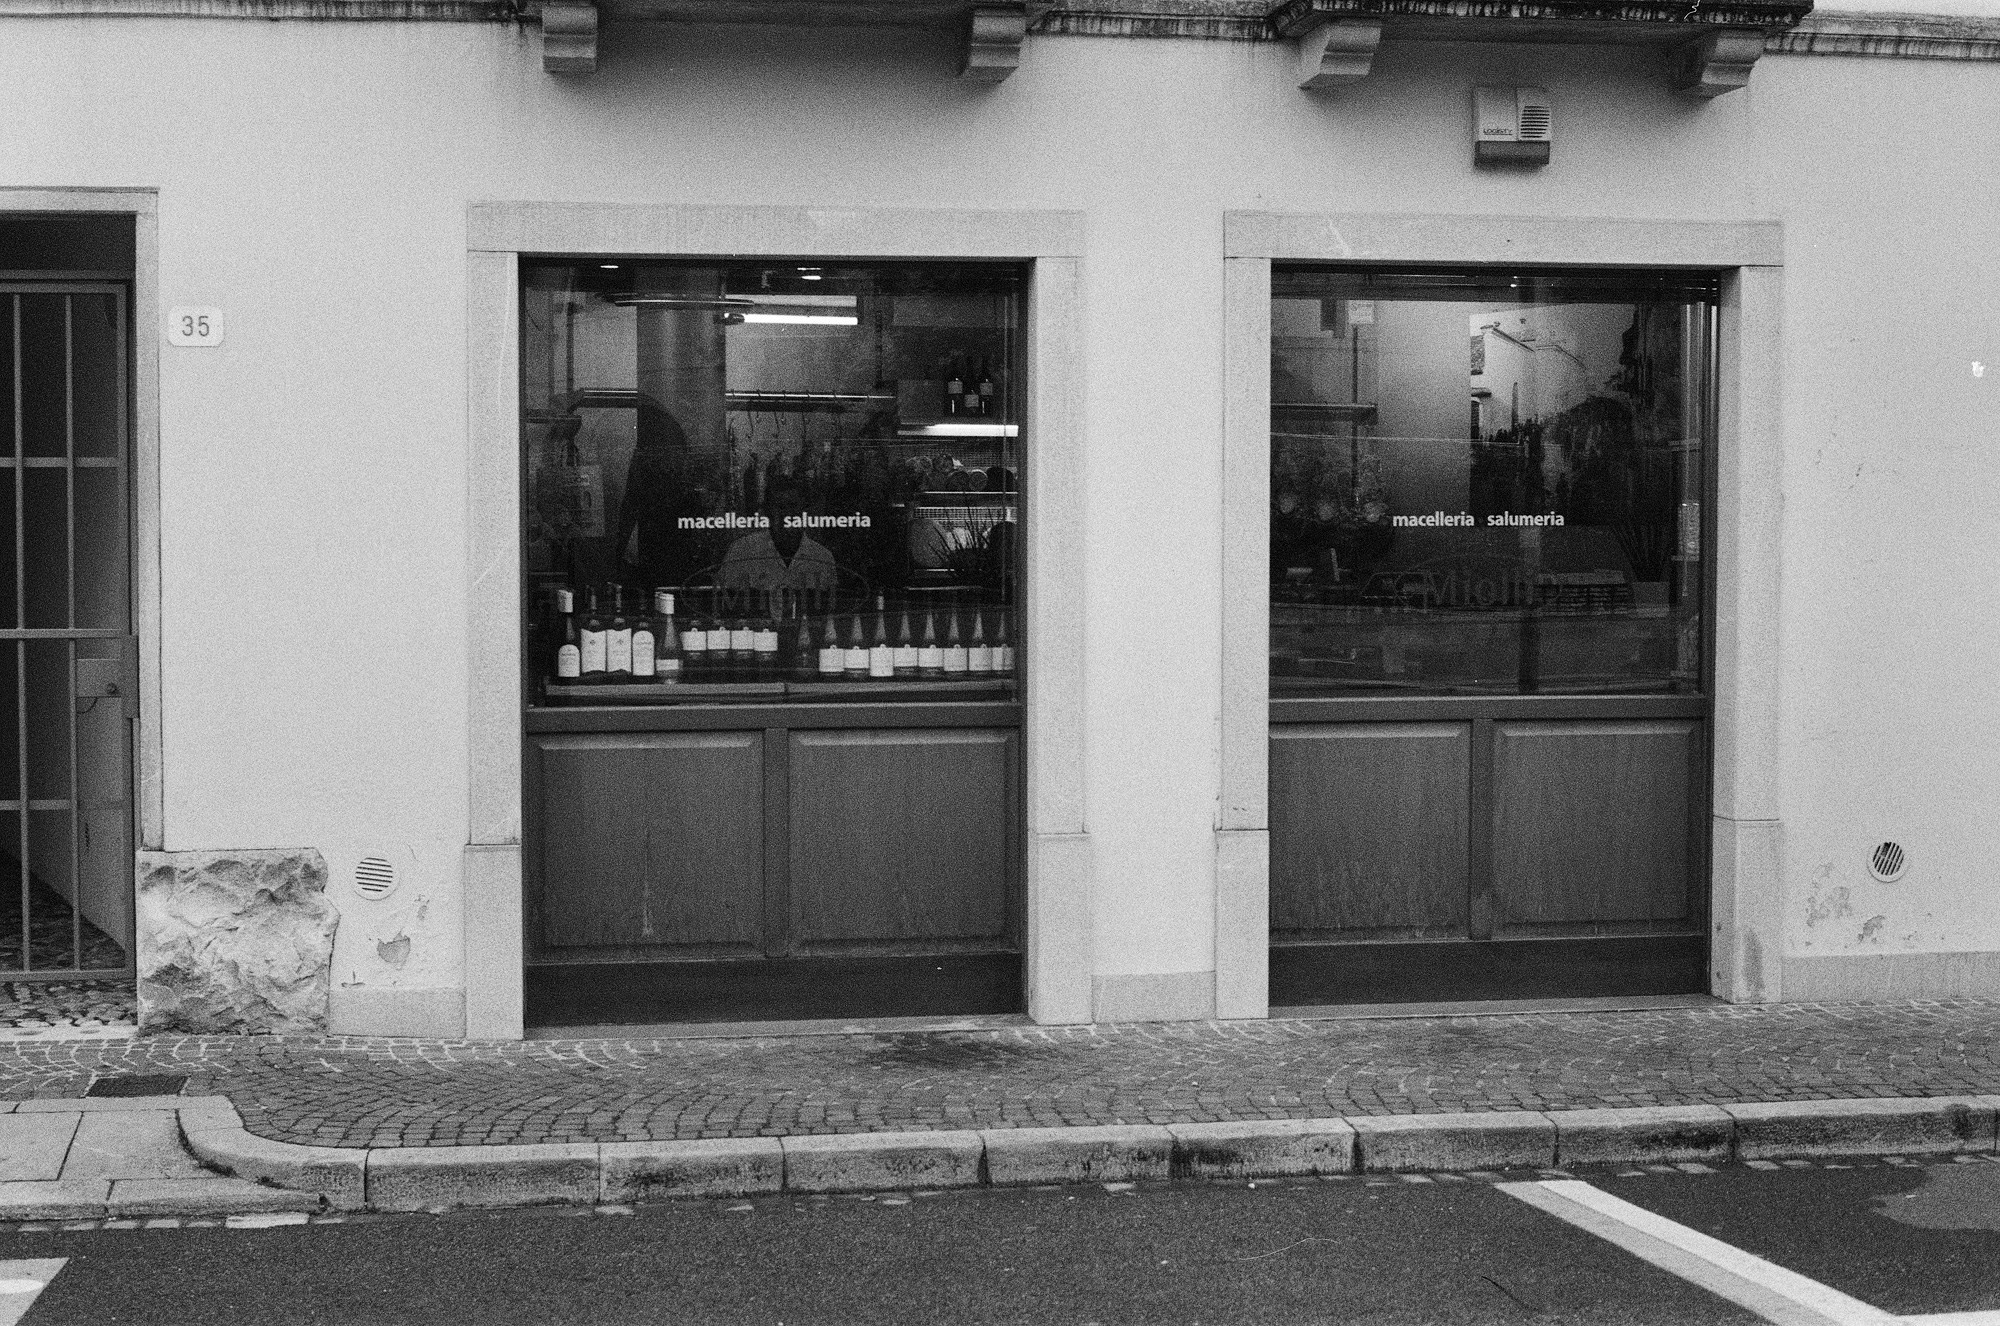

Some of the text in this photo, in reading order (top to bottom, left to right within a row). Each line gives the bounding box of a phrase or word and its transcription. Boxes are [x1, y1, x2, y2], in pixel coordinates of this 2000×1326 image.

[181, 315, 210, 337] 35
[677, 511, 872, 529] macelleria salumeria
[1392, 510, 1565, 527] macelleria salumeria
